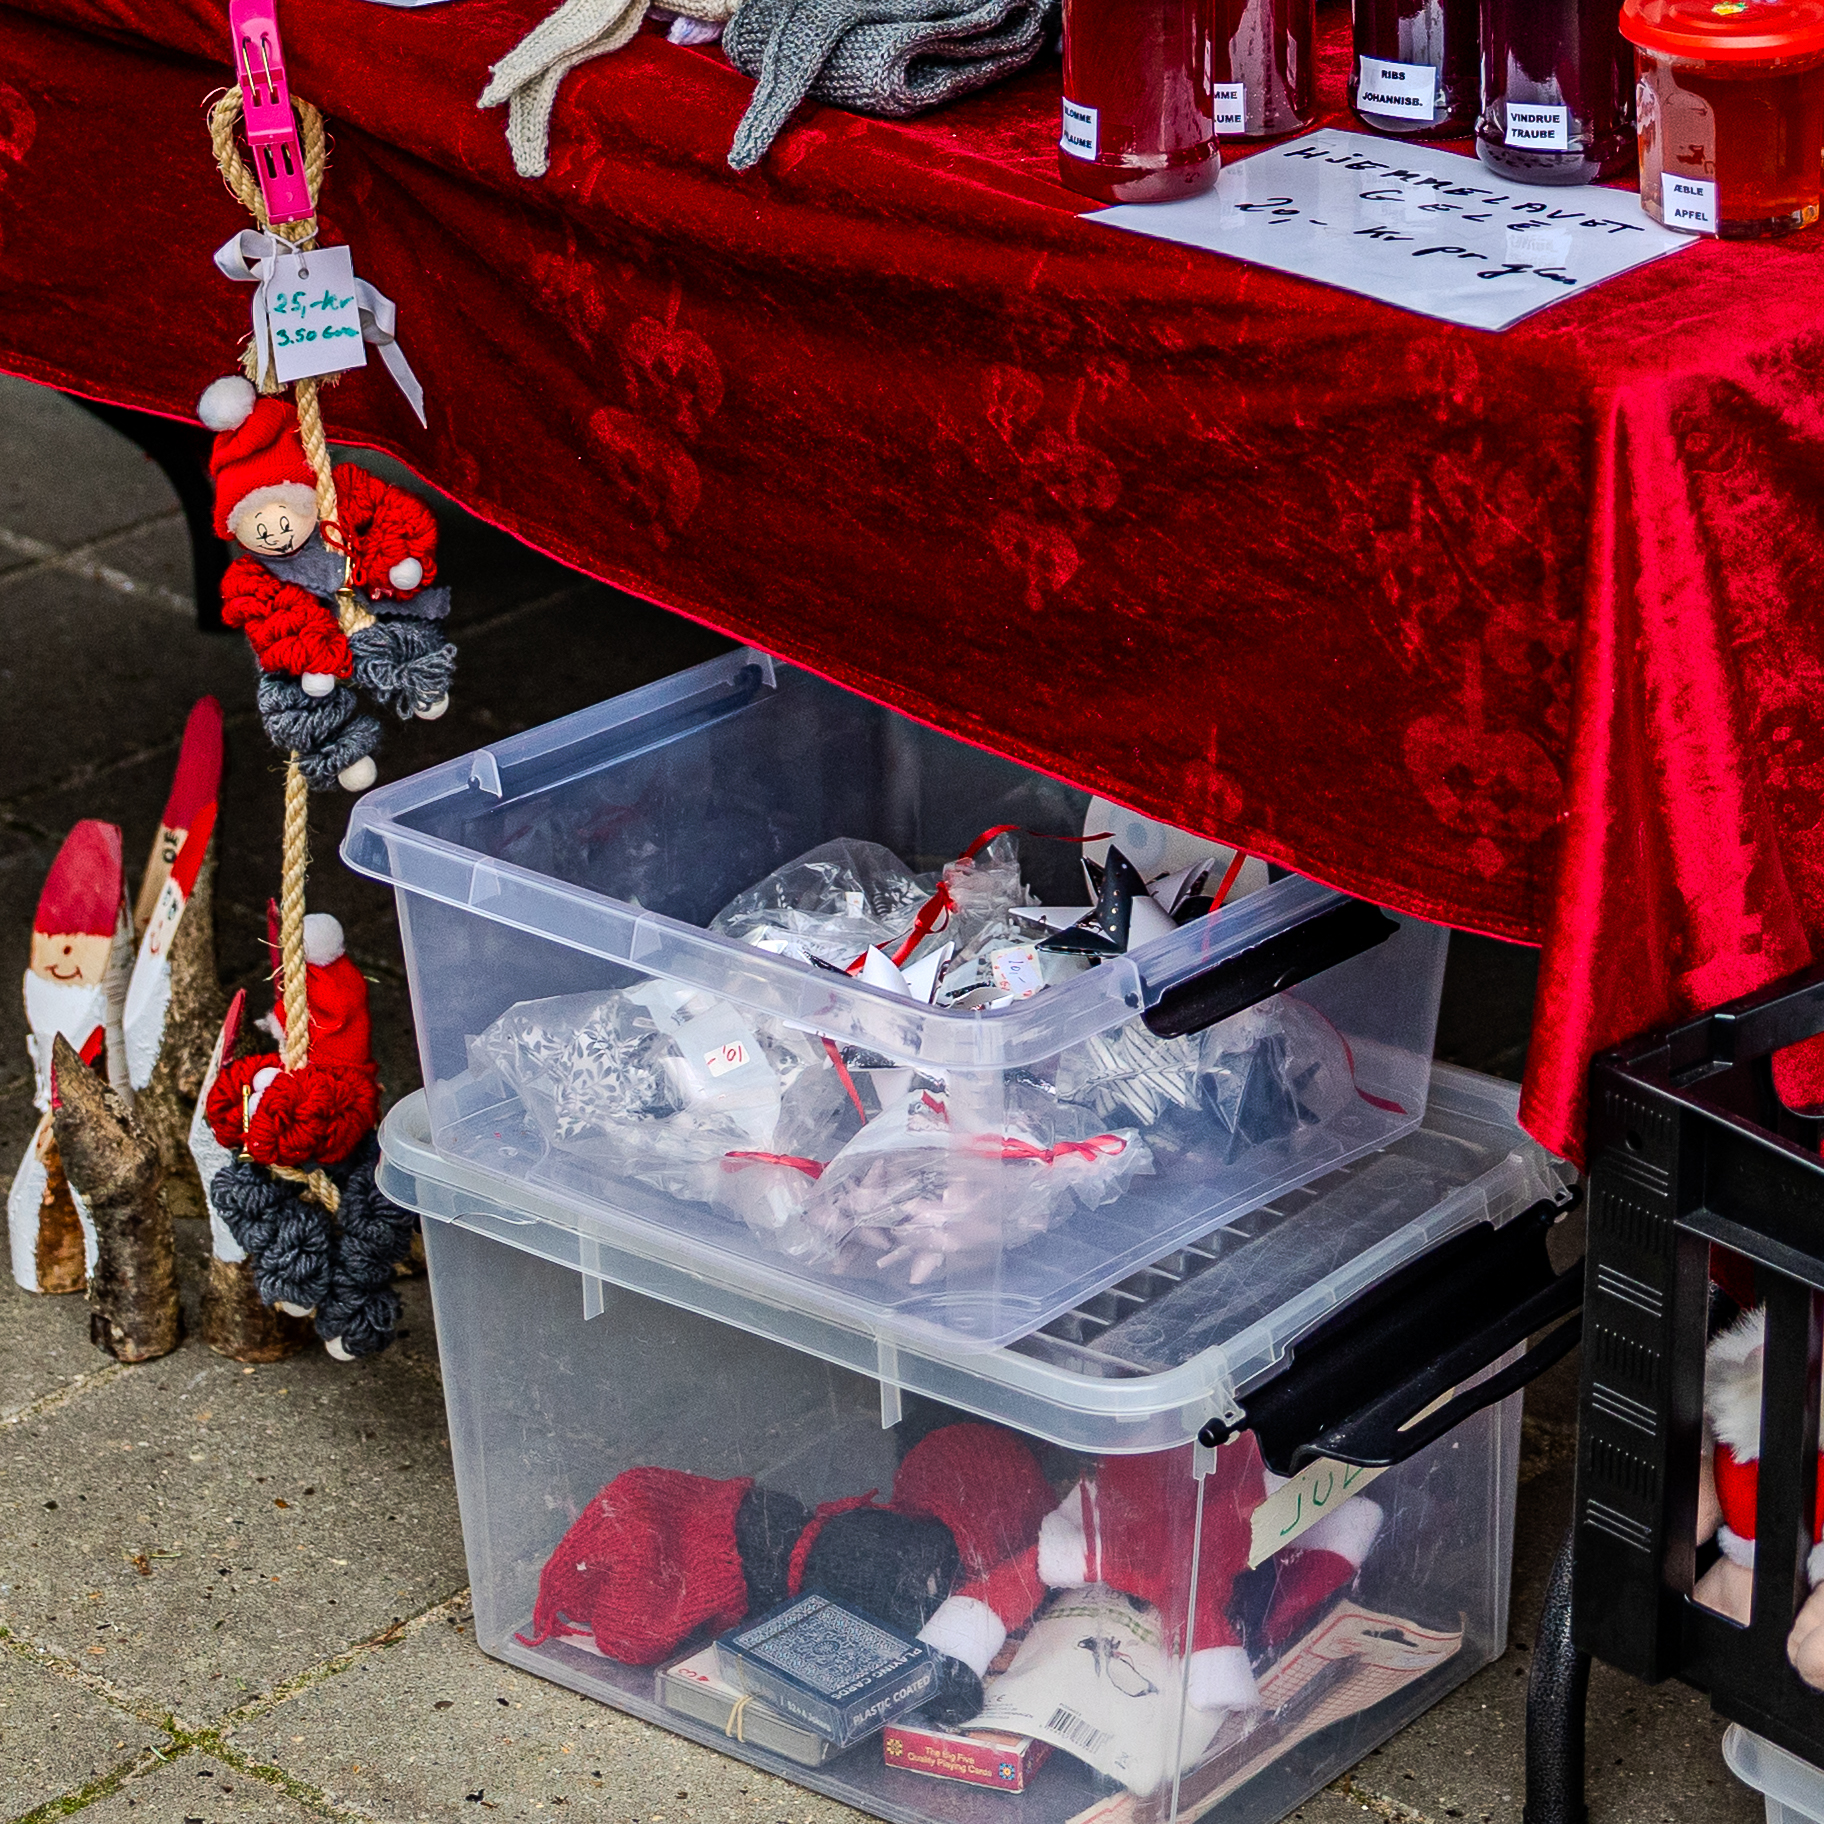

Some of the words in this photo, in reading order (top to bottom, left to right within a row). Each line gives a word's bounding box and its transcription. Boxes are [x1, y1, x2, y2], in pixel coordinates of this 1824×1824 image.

[1380, 69, 1407, 81] RIBS
[1213, 90, 1238, 101] MME
[1362, 92, 1424, 107] JOHANNISB.
[1213, 114, 1242, 124] UME
[1510, 112, 1561, 124] VINDRUE
[1511, 128, 1556, 139] TRAUBE
[1283, 145, 1646, 234] HJEMMELAVET
[1673, 184, 1705, 197] ÆBLE
[1673, 208, 1709, 223] APFEL
[1411, 245, 1488, 260] pr
[275, 327, 318, 347] 3.50
[876, 1647, 923, 1680] PLAYING
[830, 1676, 878, 1701] CARDS
[851, 1696, 893, 1727] PLASTIC
[892, 1674, 932, 1704] COATED
[924, 1745, 941, 1758] The
[941, 1748, 956, 1764] Big
[956, 1752, 976, 1766] Five
[906, 1750, 937, 1768] Quality
[936, 1756, 967, 1776] Playing
[967, 1762, 993, 1778] Cards
